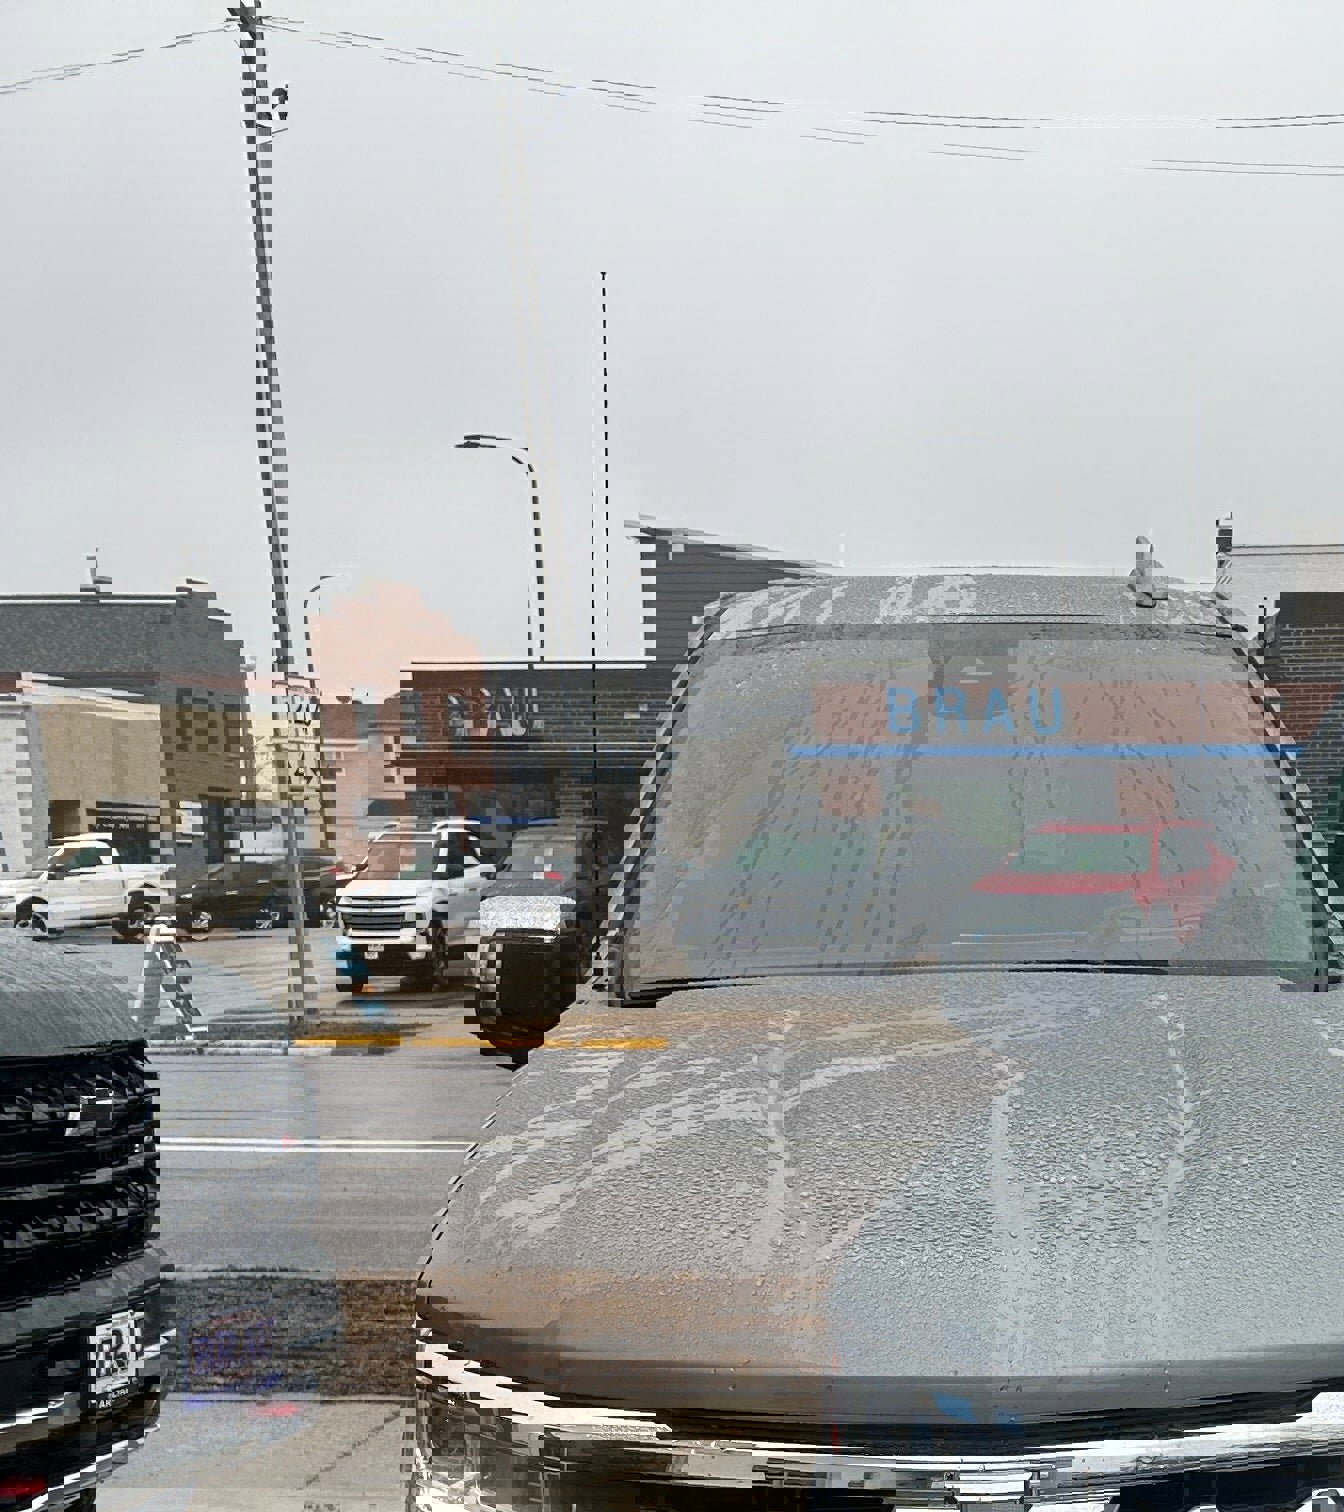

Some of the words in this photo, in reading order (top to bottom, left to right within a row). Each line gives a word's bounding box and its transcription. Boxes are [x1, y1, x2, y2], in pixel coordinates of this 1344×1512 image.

[572, 693, 592, 725] 12
[604, 696, 629, 727] 34
[885, 685, 1068, 738] BRAU
[190, 1316, 275, 1381] BRAU
[210, 1378, 260, 1402] ARLINGTON
